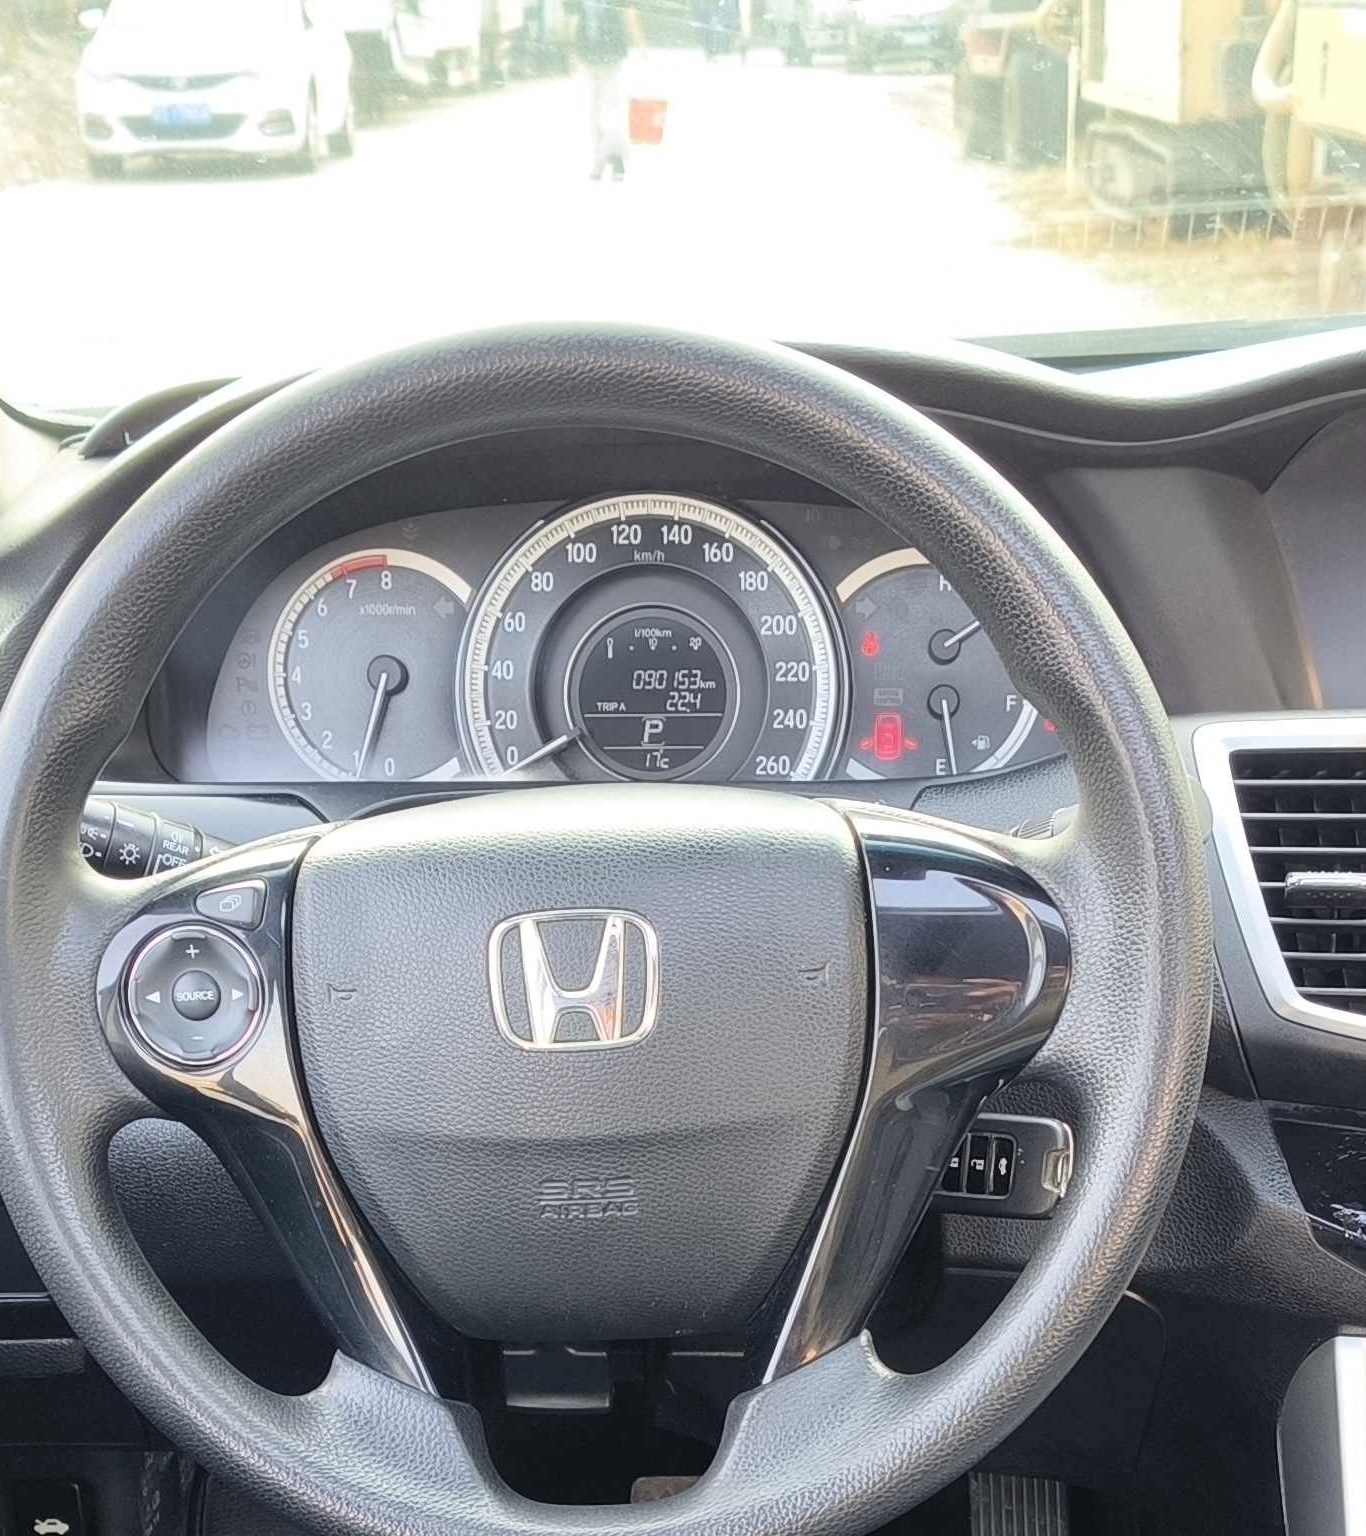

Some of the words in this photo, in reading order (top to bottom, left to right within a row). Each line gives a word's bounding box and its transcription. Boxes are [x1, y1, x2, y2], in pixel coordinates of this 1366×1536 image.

[611, 524, 642, 545] 120
[661, 525, 692, 545] 140
[566, 542, 597, 563] 100
[634, 549, 665, 562] km/h
[703, 542, 734, 563] 160
[346, 579, 357, 599] 7
[380, 570, 392, 590] 8
[530, 571, 554, 592] 80
[738, 571, 769, 591] 180
[317, 598, 328, 617] 6
[359, 604, 416, 616] x1000r/min
[504, 612, 526, 632] 60
[760, 615, 797, 636] 200
[298, 630, 309, 649] 5
[606, 637, 614, 647] 0
[648, 638, 658, 647] 10
[689, 637, 702, 647] 20
[291, 666, 302, 685] 4
[491, 660, 514, 680] 40
[775, 661, 810, 682] 220
[301, 702, 312, 721] 3
[596, 702, 619, 712] TRIP
[666, 692, 701, 712] 22.4
[1006, 694, 1017, 712] F
[494, 709, 518, 730] 20
[773, 709, 807, 729] 240
[322, 731, 333, 749] 2
[643, 719, 663, 743] P
[352, 750, 360, 767] 1
[506, 746, 518, 765] 0
[384, 757, 396, 776] 0
[755, 756, 790, 775] 260
[936, 759, 946, 775] E
[162, 840, 190, 856] REAR
[176, 991, 215, 1002] SOURCE
[535, 1179, 635, 1199] SRS
